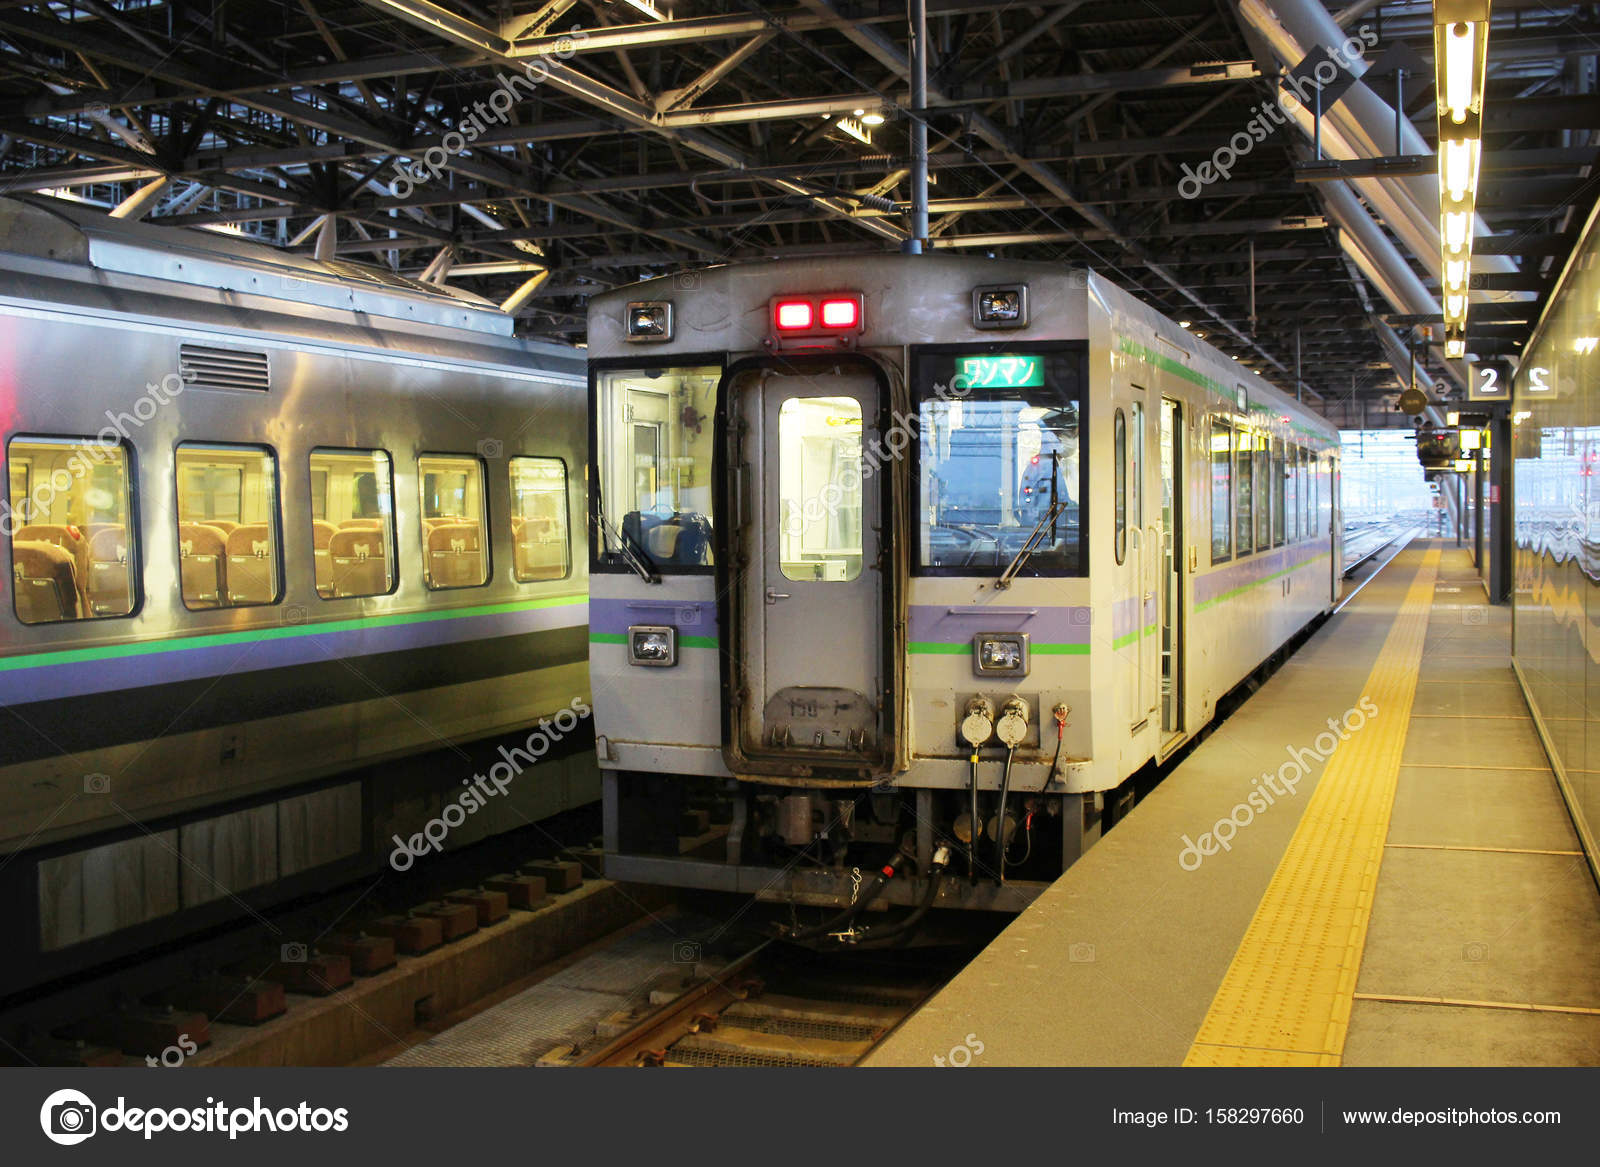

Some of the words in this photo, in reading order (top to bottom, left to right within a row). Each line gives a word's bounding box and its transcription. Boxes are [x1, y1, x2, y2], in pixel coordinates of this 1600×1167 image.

[963, 358, 1035, 386] ワンマン
[1480, 368, 1498, 392] 2
[703, 378, 715, 400] 7
[1435, 383, 1446, 395] 2
